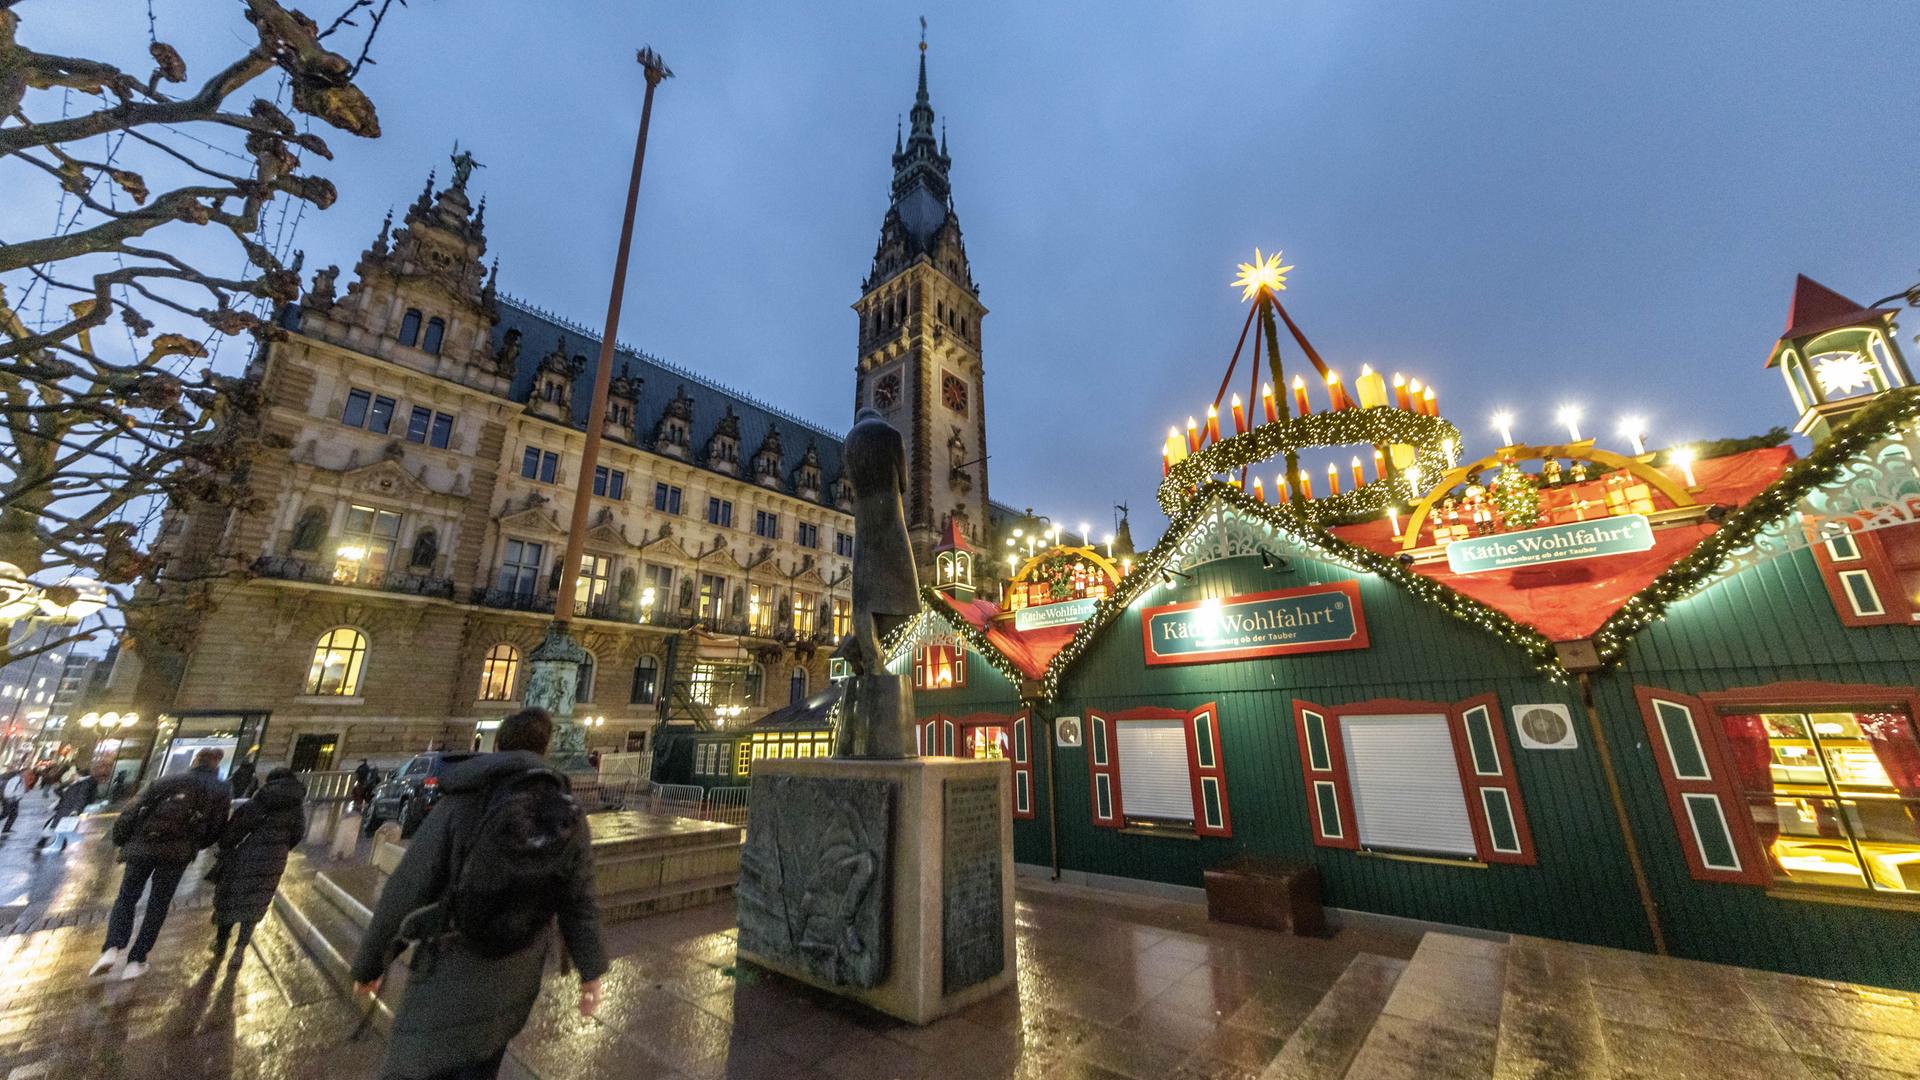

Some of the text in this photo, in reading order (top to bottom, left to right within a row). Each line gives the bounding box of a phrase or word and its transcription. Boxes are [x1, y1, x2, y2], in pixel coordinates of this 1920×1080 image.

[1461, 523, 1634, 561] Käthe Wohlfahrt
[1163, 606, 1335, 640] Kät Wohlfahrt
[1240, 635, 1251, 643] ob
[1252, 633, 1266, 642] der
[1268, 631, 1297, 641] Tauber
